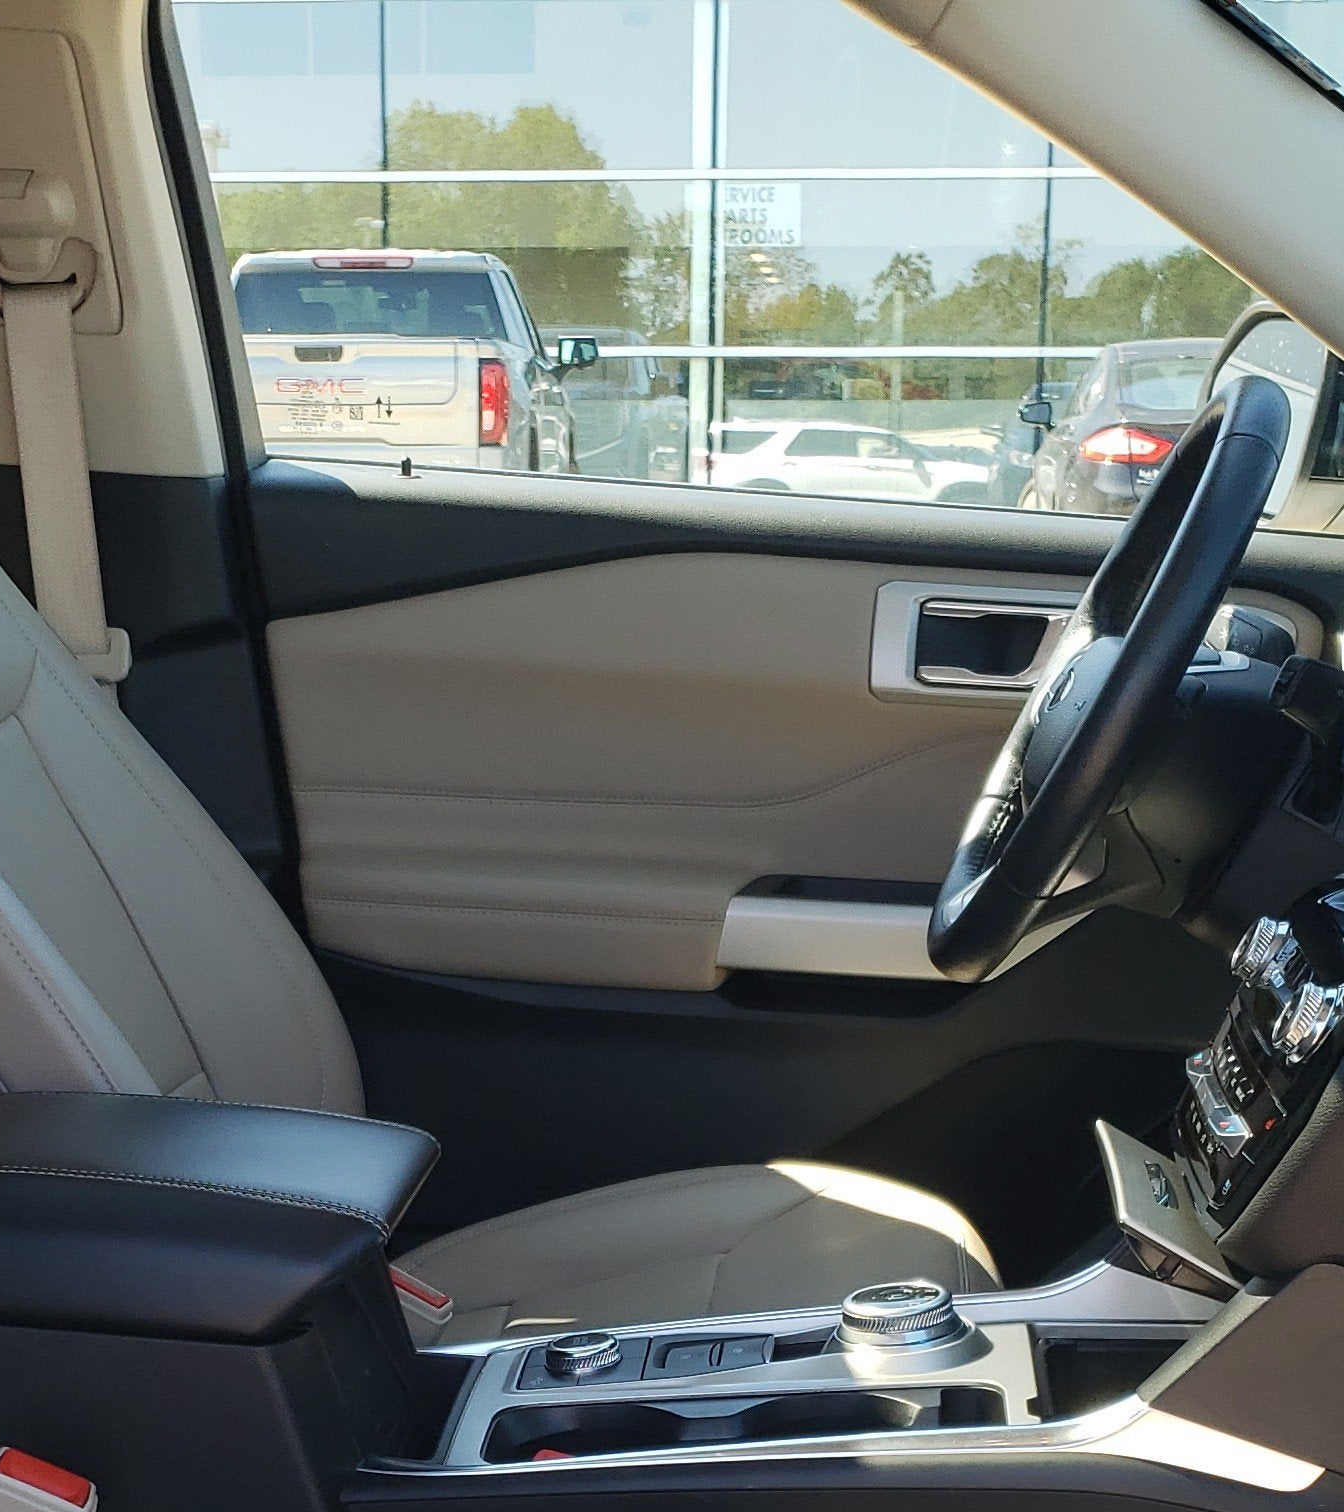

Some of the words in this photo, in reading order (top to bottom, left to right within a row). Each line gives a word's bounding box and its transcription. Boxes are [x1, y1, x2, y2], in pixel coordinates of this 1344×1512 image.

[725, 186, 776, 203] ERVICE
[724, 208, 768, 224] ARTS
[725, 228, 795, 245] ROOMS
[275, 377, 367, 395] GMC
